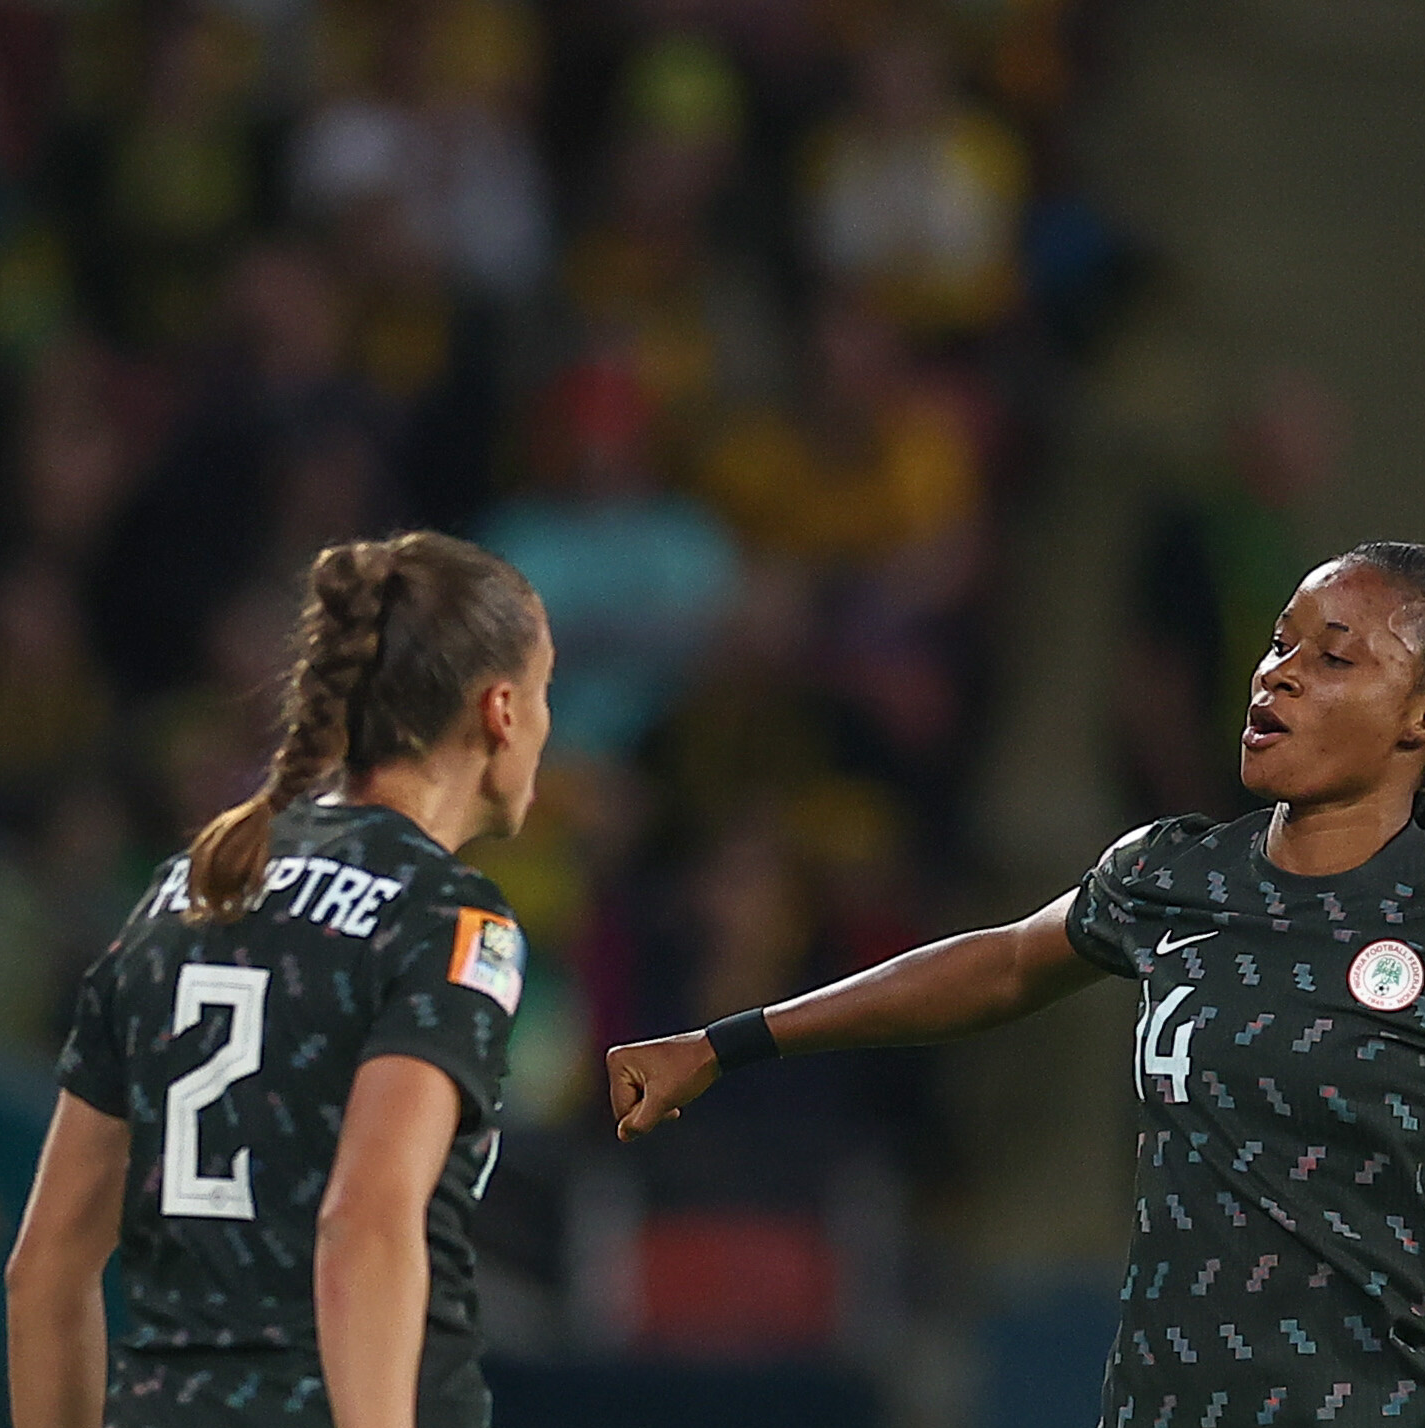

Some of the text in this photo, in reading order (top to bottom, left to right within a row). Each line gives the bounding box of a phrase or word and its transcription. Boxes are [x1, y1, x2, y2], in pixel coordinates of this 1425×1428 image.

[1365, 943, 1408, 959] FOOTBALL
[1397, 955, 1420, 1005] FEDERATION
[160, 962, 272, 1222] 2
[1134, 978, 1196, 1103] 14
